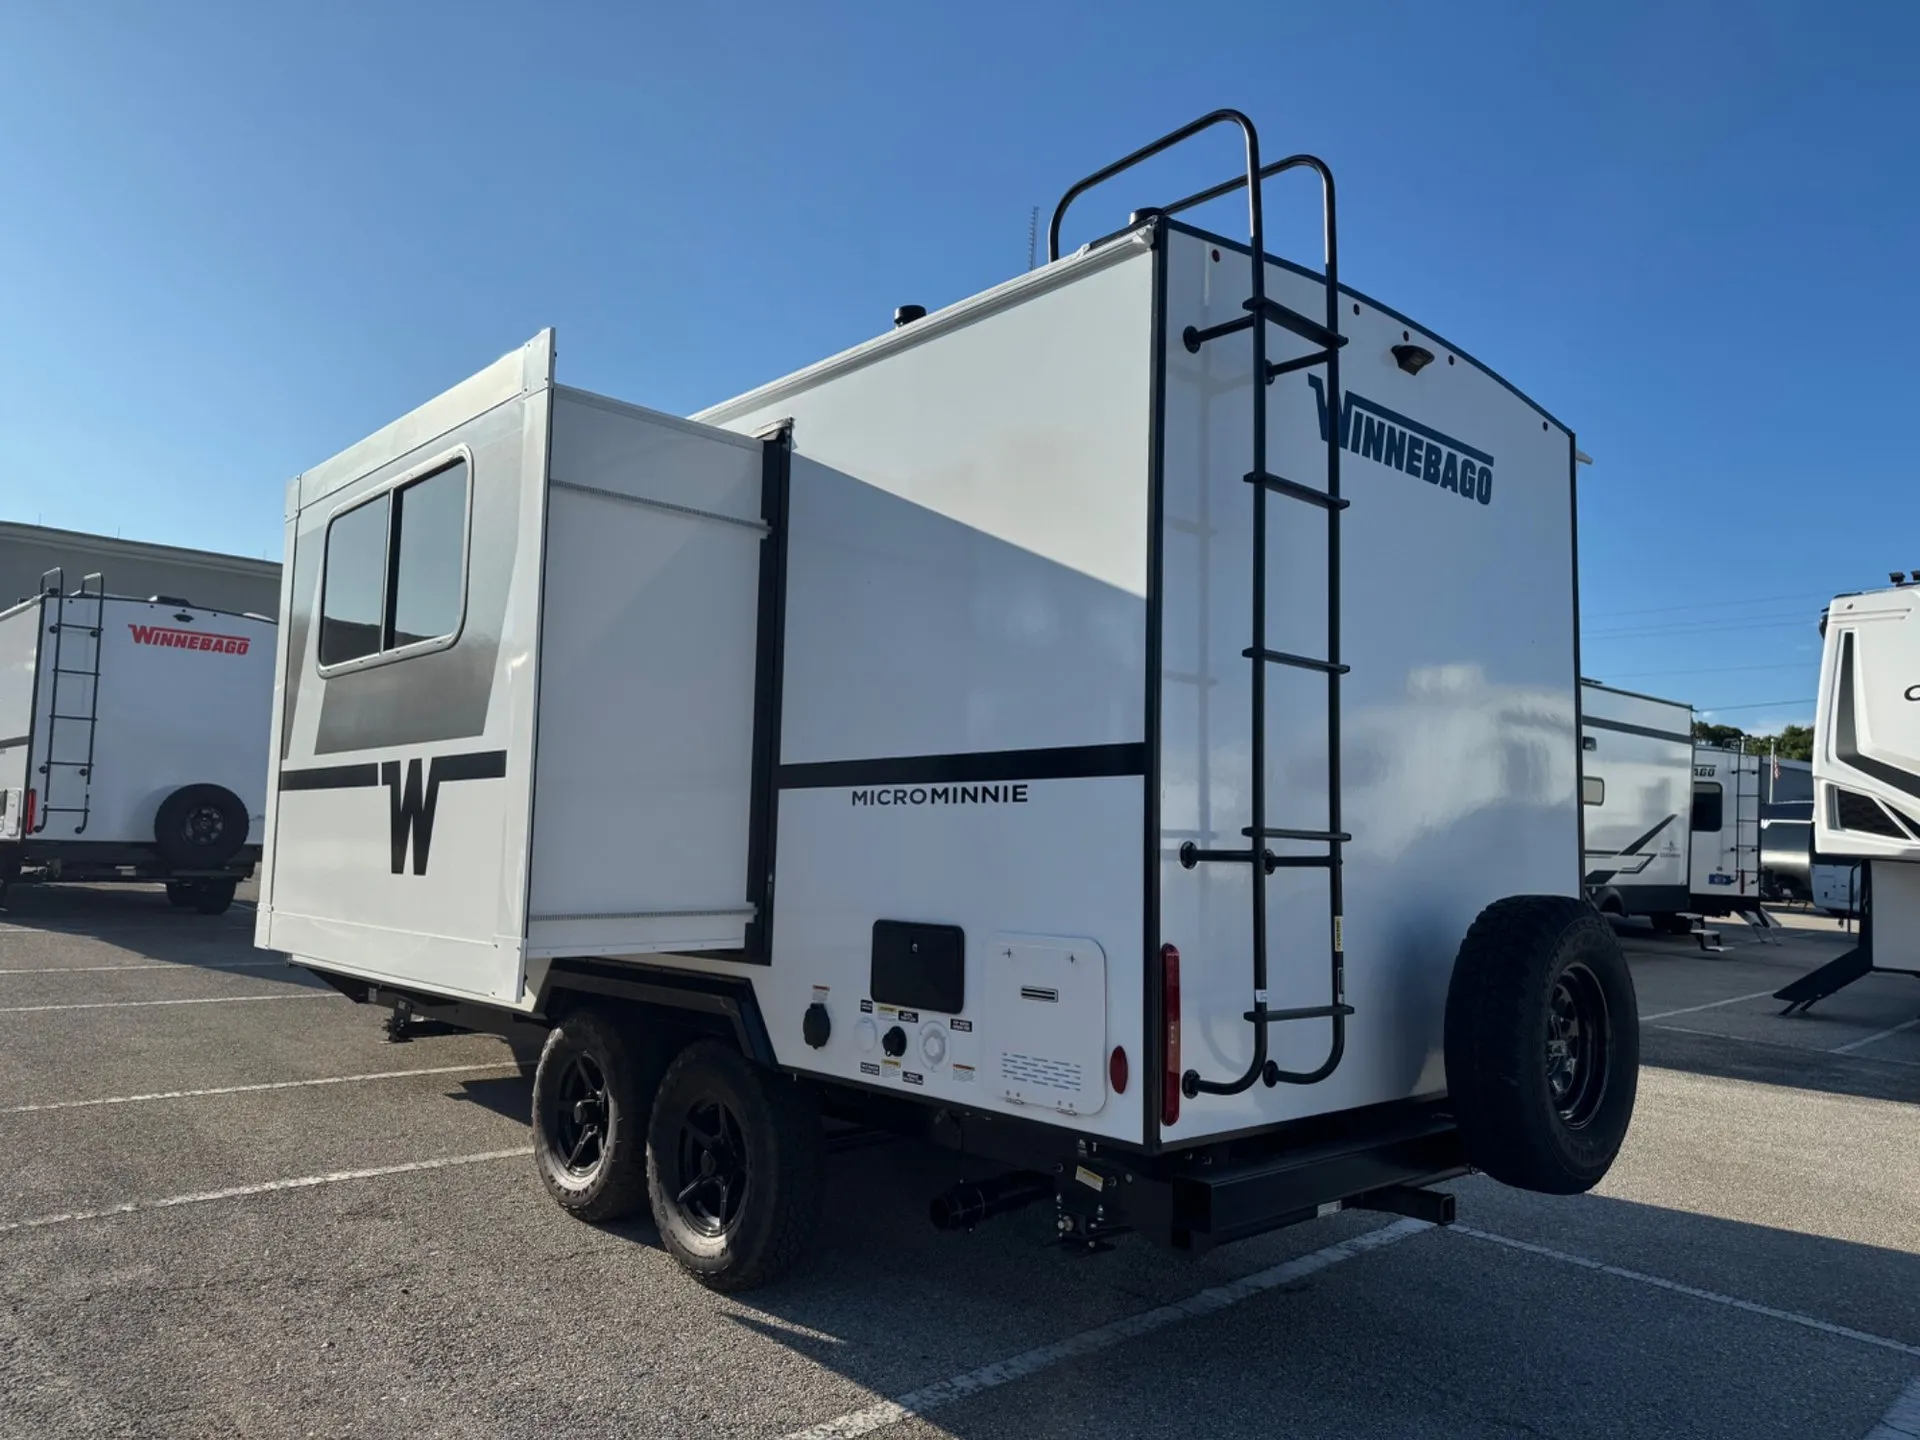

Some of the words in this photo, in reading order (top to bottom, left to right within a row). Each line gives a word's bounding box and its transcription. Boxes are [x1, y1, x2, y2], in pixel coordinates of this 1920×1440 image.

[1308, 373, 1495, 505] WINNEBAGO
[128, 623, 251, 655] WINNEBAGO
[382, 757, 441, 876] W
[851, 784, 1029, 807] MICROMINNIE
